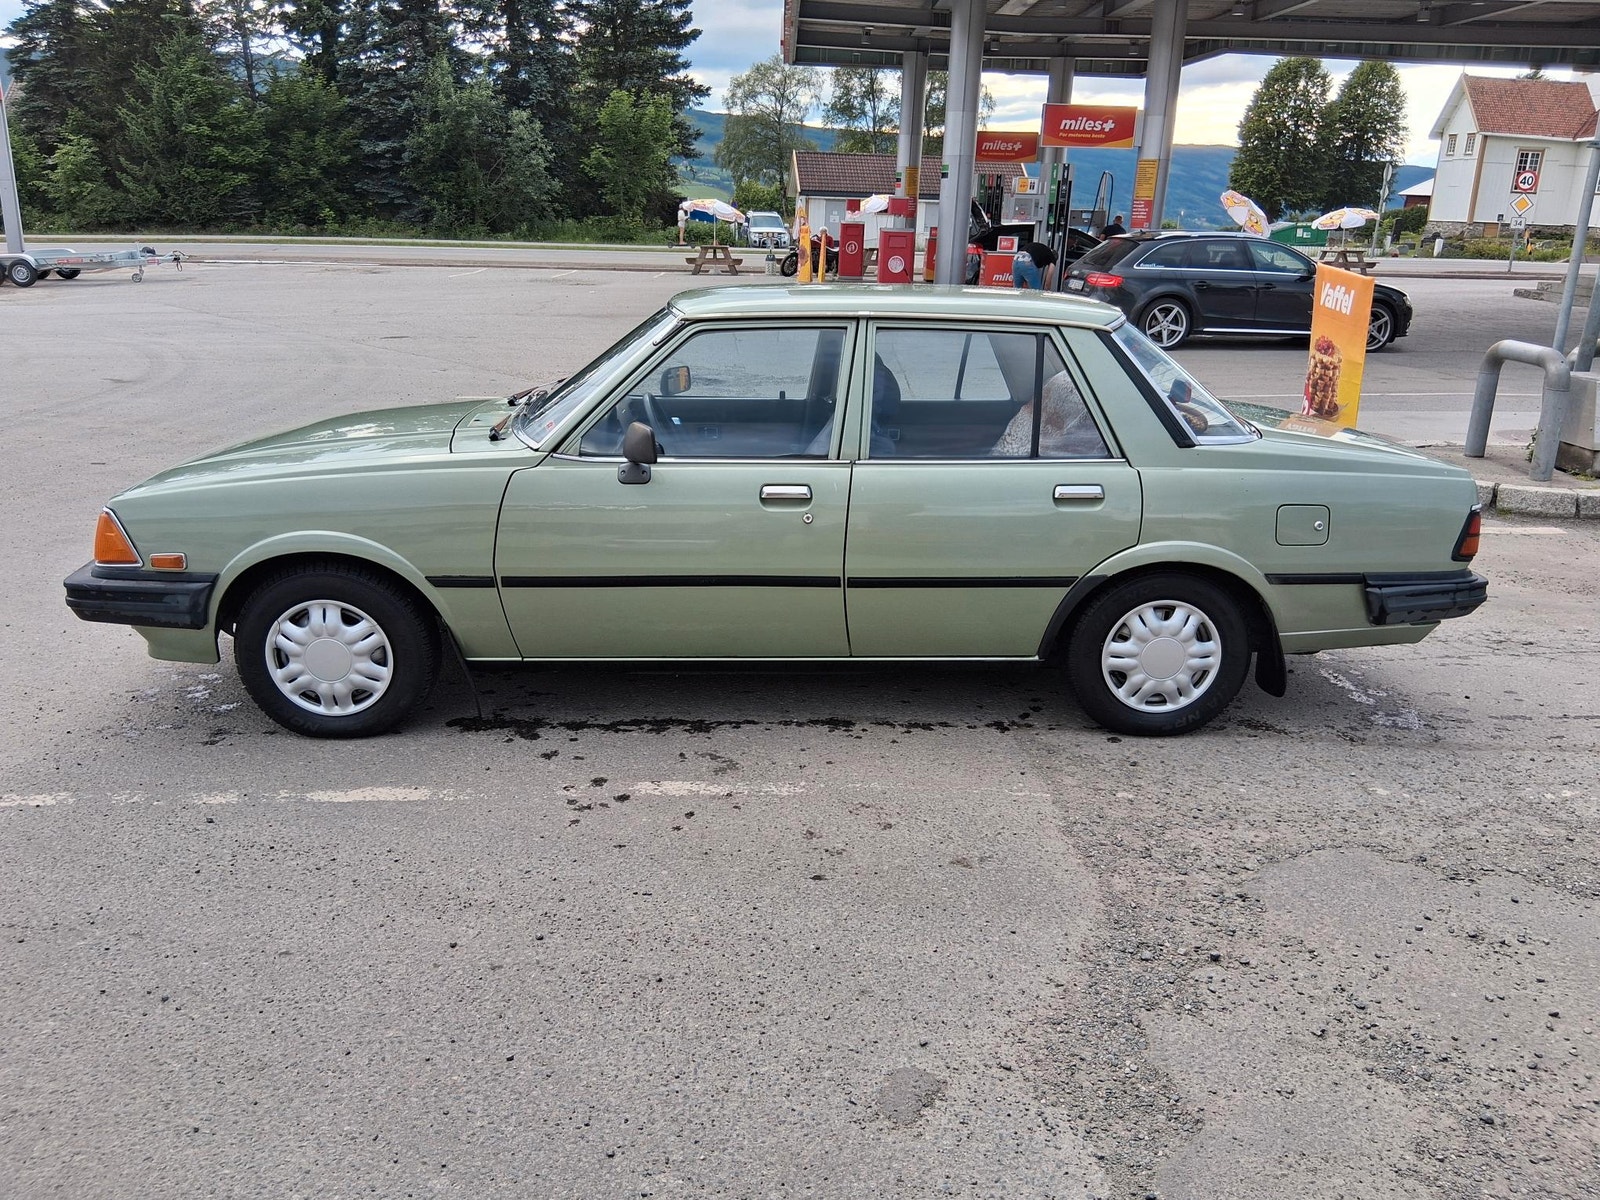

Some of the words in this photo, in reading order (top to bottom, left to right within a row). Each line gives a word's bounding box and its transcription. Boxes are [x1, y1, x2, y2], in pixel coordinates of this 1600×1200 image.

[1520, 175, 1534, 186] 40
[1513, 219, 1523, 227] 34
[993, 273, 1014, 281] mile
[1320, 281, 1355, 315] Vaffel
